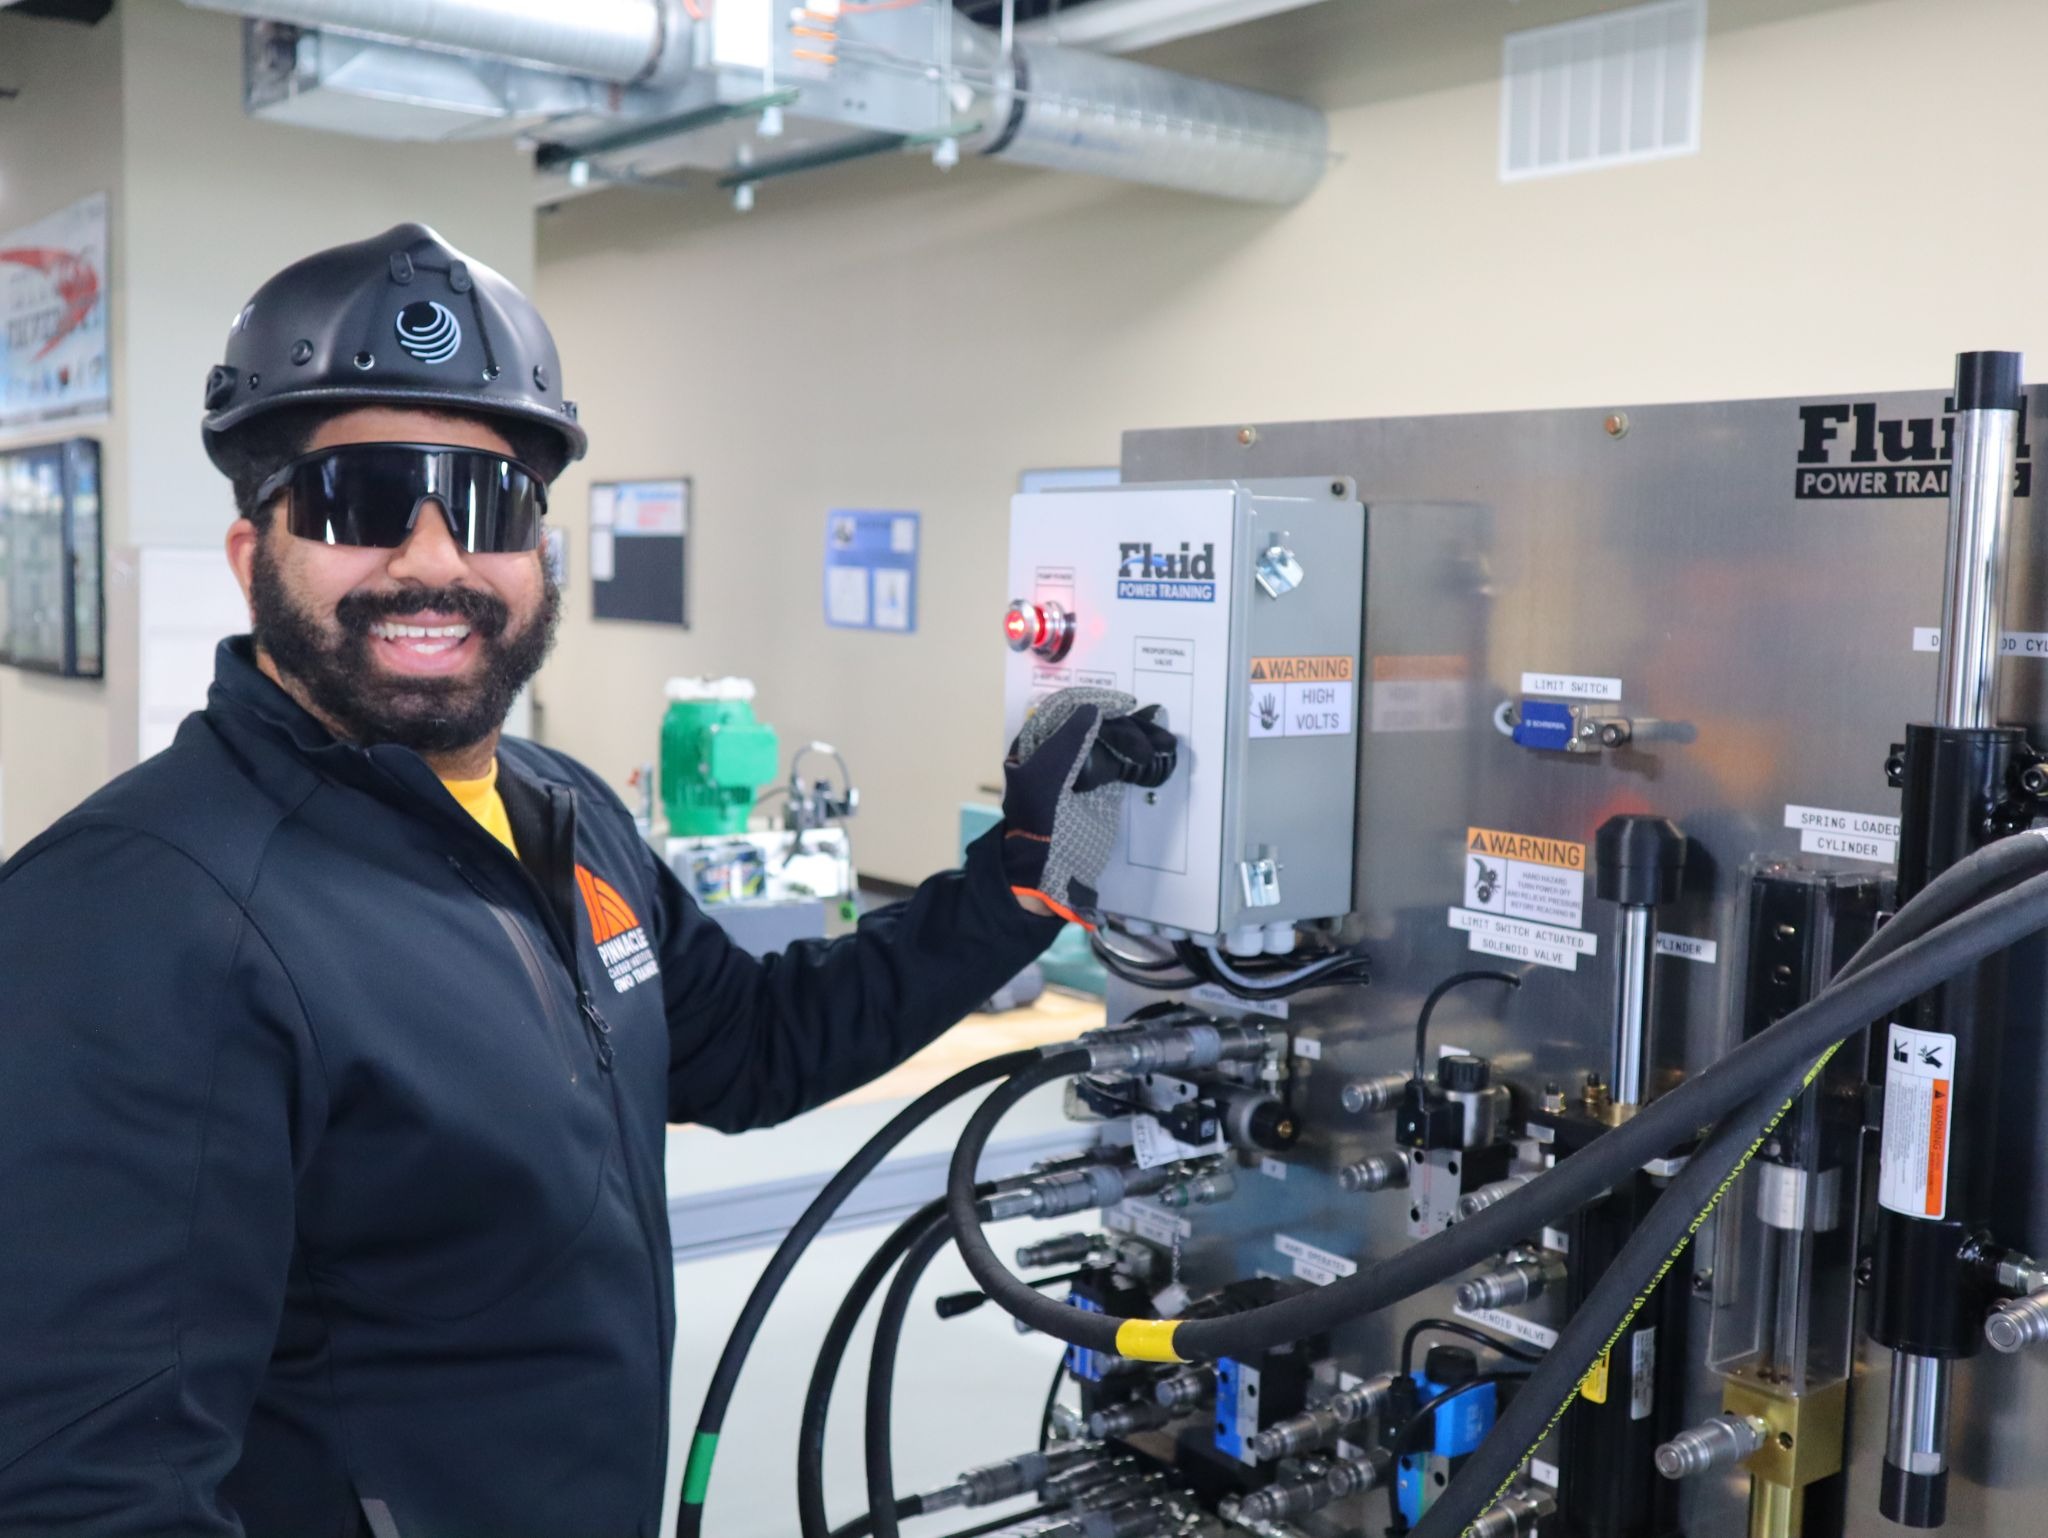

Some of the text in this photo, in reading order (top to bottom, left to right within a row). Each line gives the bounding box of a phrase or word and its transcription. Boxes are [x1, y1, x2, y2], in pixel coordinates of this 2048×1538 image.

[1798, 395, 2030, 464] Flui
[1803, 472, 1887, 495] POWER
[1118, 542, 1214, 580] Fluid
[1120, 583, 1211, 600] POWER TRAINING
[1268, 660, 1349, 680] WARNING
[1302, 689, 1335, 704] HIGH
[1535, 679, 1608, 694] LIMIT SWITCH
[1297, 713, 1340, 730] VOLTS
[1801, 812, 1900, 837] SPRING LOADED
[1489, 832, 1580, 867] WARNING
[1817, 837, 1879, 857] CYLINDER
[1461, 915, 1585, 949] LIMIT SWITCH ACTUATED
[597, 926, 650, 968] PINNACLE
[1482, 937, 1564, 965] SOLENOID VALVE
[1657, 938, 1703, 955] YLINDER
[1932, 1104, 1944, 1151] WARNING
[1473, 1311, 1546, 1341] OLENOID VALVE
